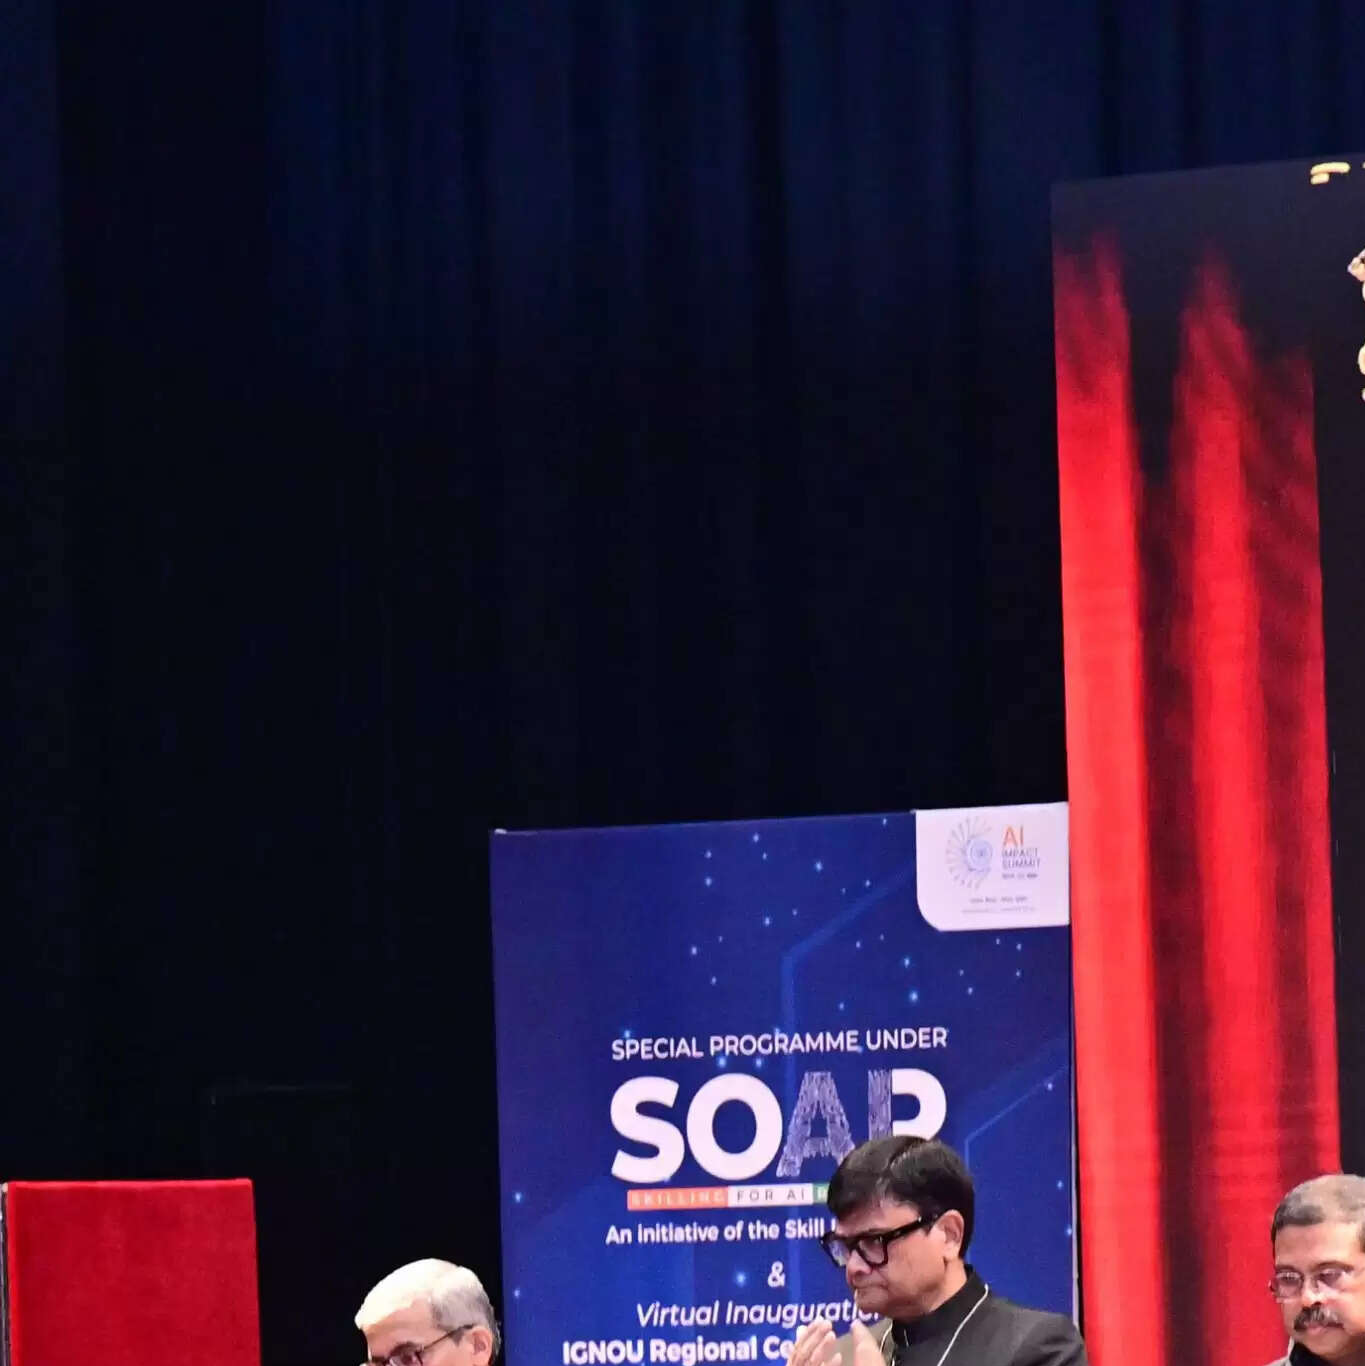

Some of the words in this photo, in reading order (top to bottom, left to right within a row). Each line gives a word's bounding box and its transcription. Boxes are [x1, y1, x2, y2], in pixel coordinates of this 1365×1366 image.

[1002, 825, 1025, 848] AI
[612, 1036, 704, 1061] SPECIAL
[710, 1029, 858, 1056] PROGRAMME
[866, 1027, 949, 1050] UNDER
[737, 1188, 774, 1202] FOR
[786, 1187, 805, 1201] AI
[605, 1224, 632, 1245] An
[637, 1221, 719, 1244] initiative
[724, 1219, 743, 1240] of
[748, 1219, 780, 1240] the
[785, 1217, 824, 1240] Skill
[767, 1260, 786, 1288] &
[636, 1300, 719, 1327] Virtual
[563, 1339, 645, 1366] IGNOU
